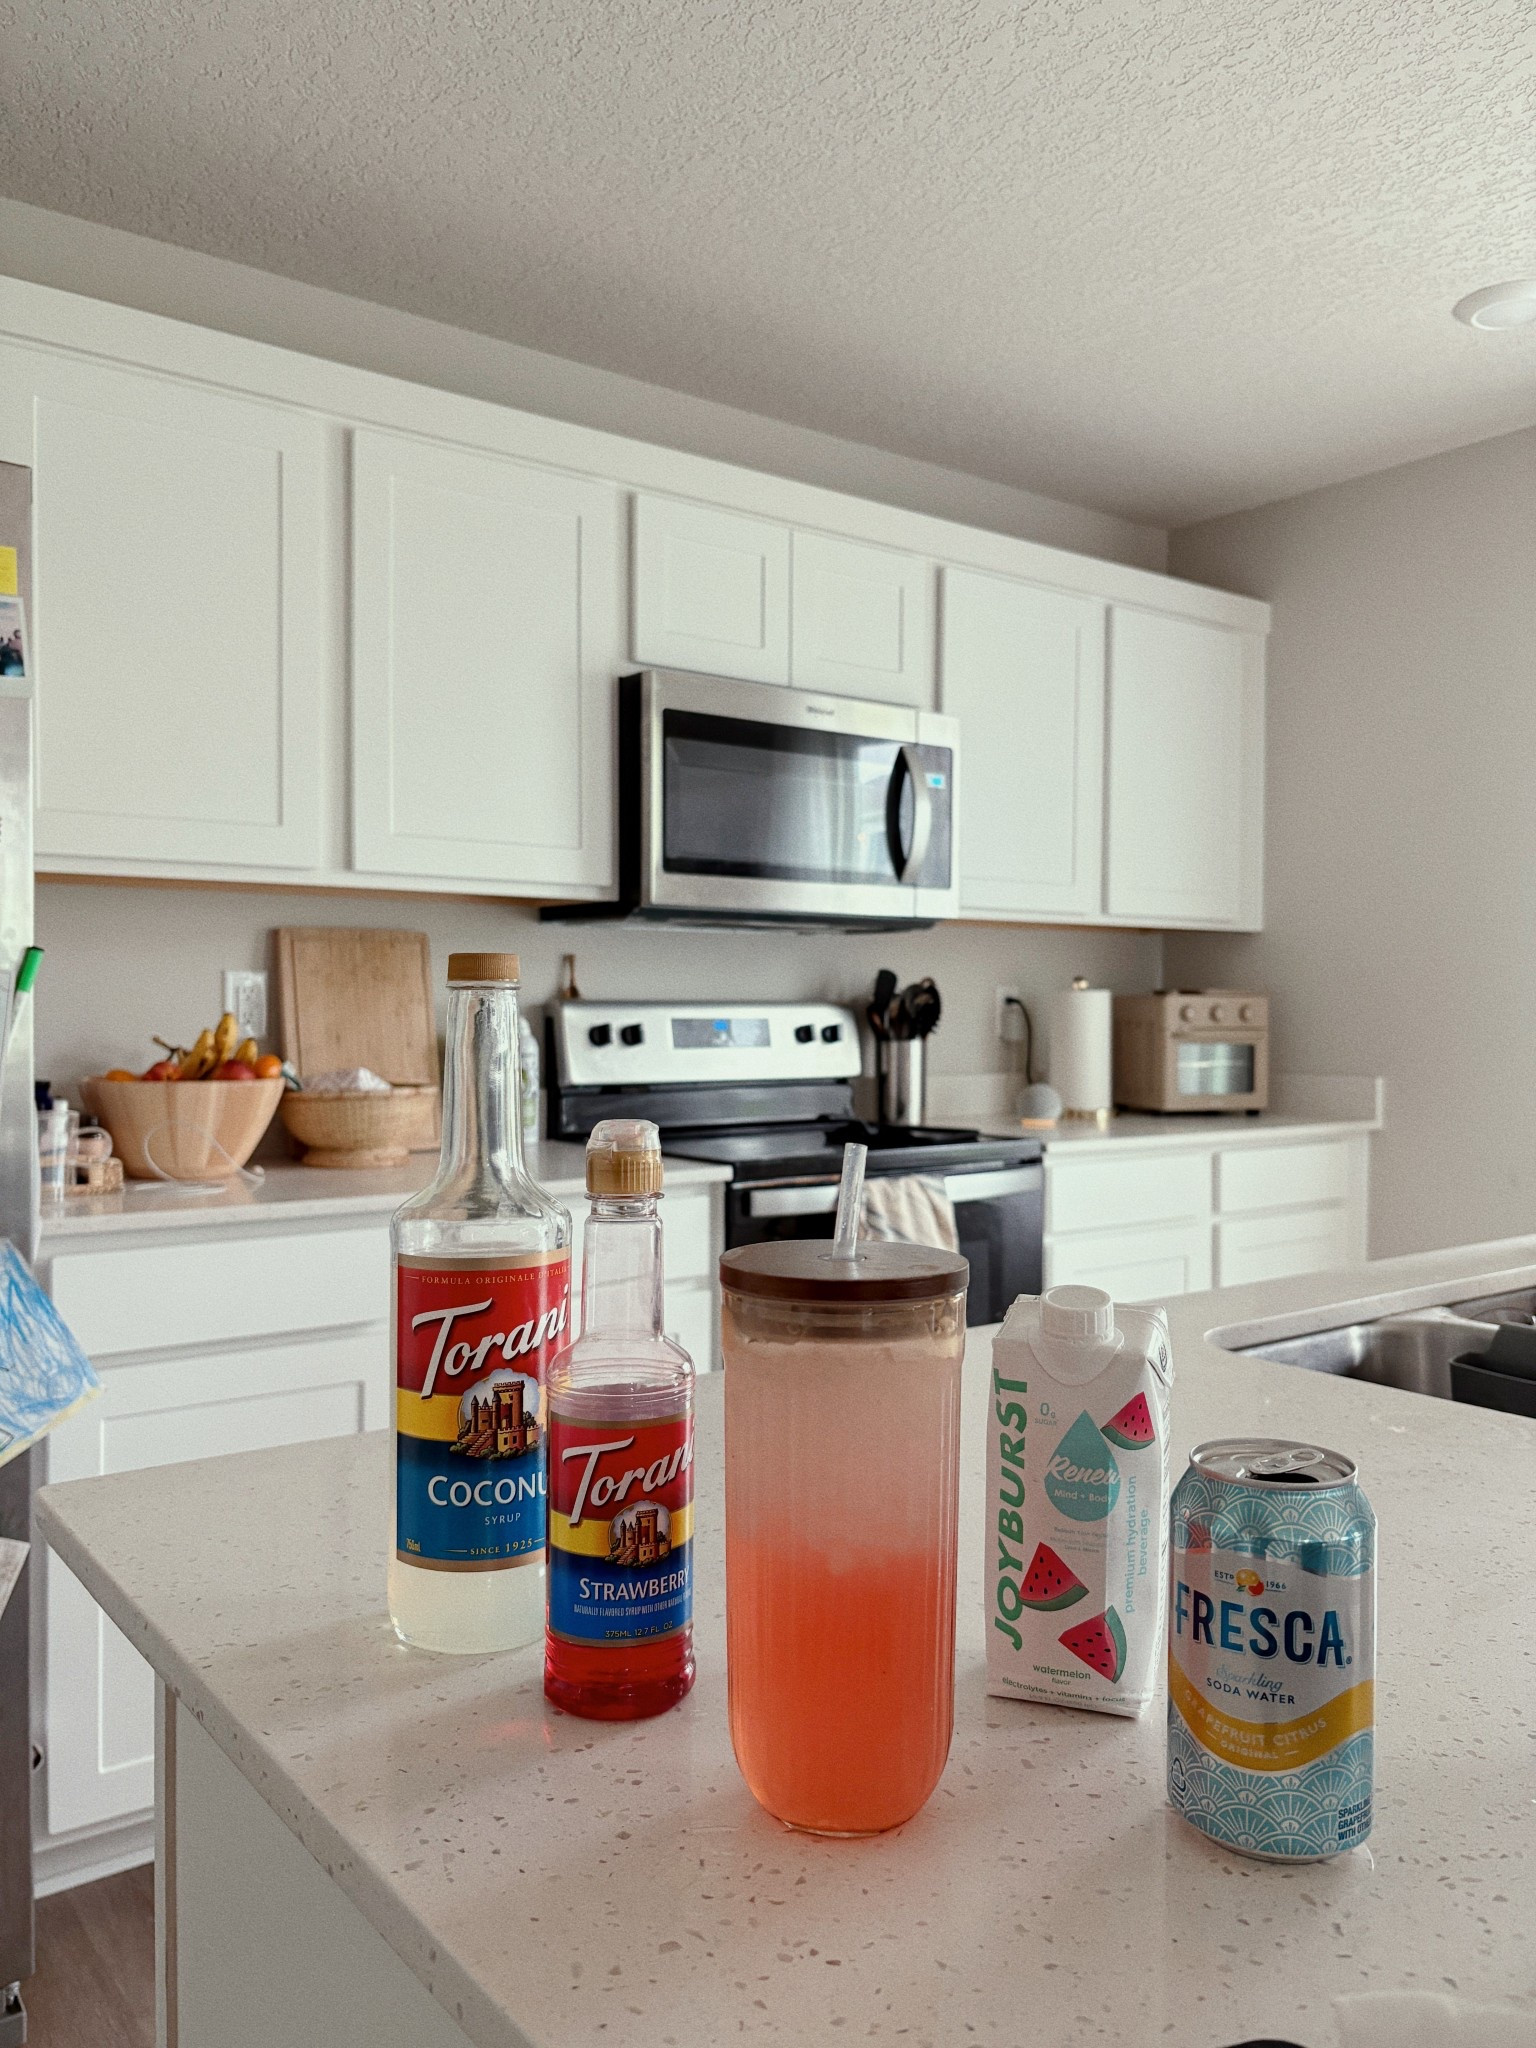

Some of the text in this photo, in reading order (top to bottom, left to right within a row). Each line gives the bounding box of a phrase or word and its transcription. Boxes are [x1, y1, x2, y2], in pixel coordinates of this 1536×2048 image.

[421, 1275, 471, 1285] FORMULA
[476, 1272, 535, 1285] ORIGINALE
[412, 1283, 569, 1399] Torani
[1034, 1416, 1057, 1426] SUGAR
[562, 1420, 694, 1526] Torani
[1048, 1455, 1120, 1486] Renew
[1054, 1488, 1078, 1500] Mind
[485, 1512, 521, 1526] SYRUP
[993, 1368, 1028, 1651] JOYBURST
[470, 1538, 533, 1555] SINCE 1925
[1125, 1475, 1139, 1613] premium hydration
[1138, 1509, 1151, 1576] beverage
[579, 1567, 690, 1601] STRAWBERRY
[1265, 1580, 1287, 1590] 1966
[574, 1603, 599, 1616] NATURALLY
[599, 1607, 625, 1617] FLAVORED
[625, 1606, 641, 1616] SYRUP
[641, 1604, 654, 1615] WITH
[605, 1629, 632, 1638] 375ML
[663, 1620, 673, 1630] OZ
[1175, 1580, 1347, 1668] FRESCA
[1032, 1663, 1091, 1680] watermelon
[1051, 1677, 1071, 1686] flavor
[1216, 1663, 1284, 1693] Sparkling
[1002, 1676, 1048, 1695] electrolytes
[1056, 1691, 1093, 1701] vitamins
[1206, 1677, 1295, 1705] SODA WATER
[1183, 1689, 1328, 1747] GRAPEFRUIT CITRUS
[1219, 1739, 1280, 1760] ORIGINAL
[1338, 1827, 1356, 1841] WITH
